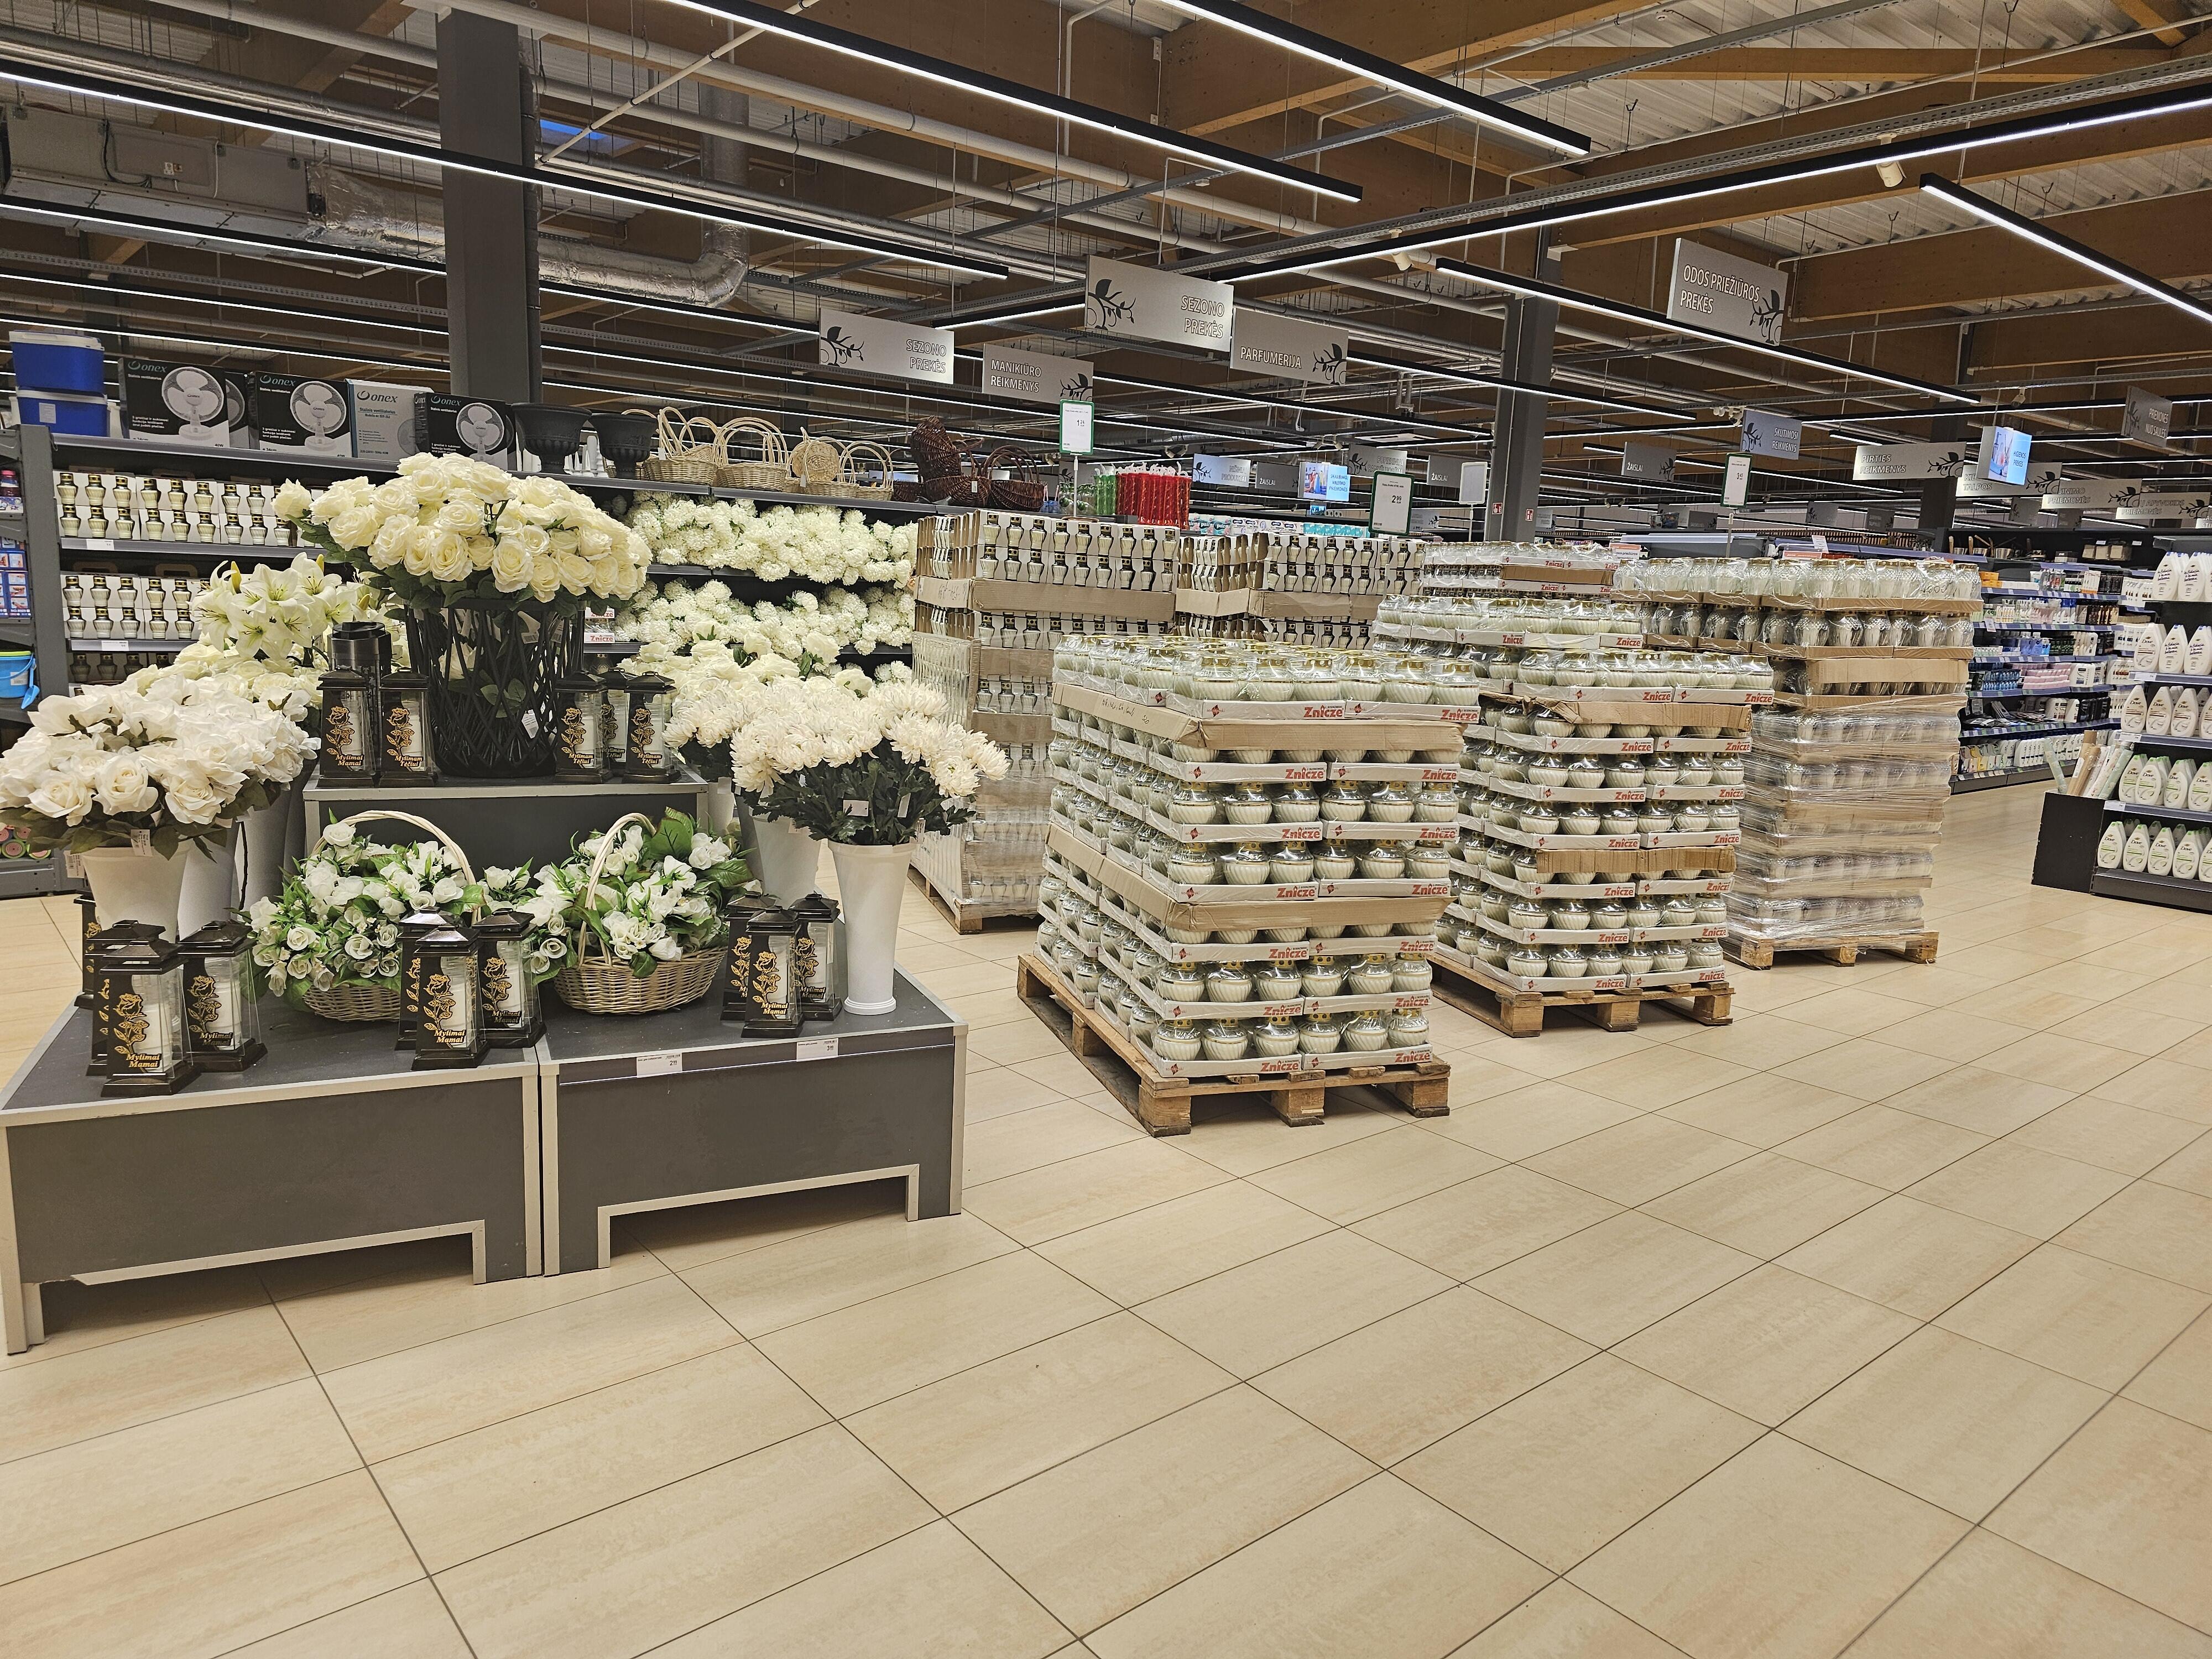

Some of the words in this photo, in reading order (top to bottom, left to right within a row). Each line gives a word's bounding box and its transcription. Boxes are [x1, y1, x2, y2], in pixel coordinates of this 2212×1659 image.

[1683, 264, 1710, 288] ODOS
[1710, 272, 1761, 303] PRIEŽIŪROS
[1181, 295, 1225, 317] SEZONO
[1680, 289, 1714, 314] PREKĖS
[1185, 317, 1224, 338] PREKĖS
[906, 339, 947, 357] SEZONO
[1240, 346, 1301, 369] PARFUMERIJA
[910, 357, 946, 373] PREKĖS
[991, 359, 1042, 377] MANIKIŪRO
[991, 375, 1040, 393] REIKMENYS
[371, 394, 398, 403] onex
[1774, 427, 1799, 441] SKUTIMOSI
[1772, 441, 1797, 453] REIKMENYS
[1861, 455, 1891, 463] PIRTIES
[1626, 462, 1644, 472] ŽAISLAI
[1859, 465, 1907, 474] REIKMENYS
[1431, 472, 1448, 482] ŽAISLAI
[1503, 634, 1524, 645] Znicze
[1616, 637, 1641, 646] Znicze
[1642, 691, 1671, 701] Znicze
[1744, 693, 1772, 703] Znicze
[1303, 705, 1343, 718] Znicze
[1440, 708, 1479, 721] Znicze
[1621, 742, 1652, 752] Znicze
[1725, 742, 1750, 751] Znicze
[1285, 767, 1324, 780] Znicze
[1422, 769, 1457, 780] Znicze
[1615, 791, 1645, 800] Znicze
[1719, 789, 1744, 797] Znicze
[1282, 827, 1321, 839] Znicze
[1420, 827, 1455, 839] Znicze
[1608, 838, 1638, 848] Znicze
[1714, 834, 1740, 844] Znicze
[1276, 886, 1315, 898] Znicze
[1412, 884, 1448, 895] Znicze
[1604, 886, 1634, 896] Znicze
[1598, 933, 1628, 942] Znicze
[1702, 927, 1726, 937] Znicze
[1400, 940, 1434, 952] Znicze
[1269, 947, 1307, 959] Znicze
[1699, 971, 1725, 980] Znicze
[1595, 979, 1625, 988] Znicze
[1395, 995, 1429, 1007] Znicze
[1263, 1005, 1301, 1016] Znicze
[200, 1032, 233, 1041] Mylimai
[126, 1053, 160, 1062] Mylimai
[1395, 1051, 1430, 1062] Znicze
[1260, 1060, 1299, 1072] Znicze
